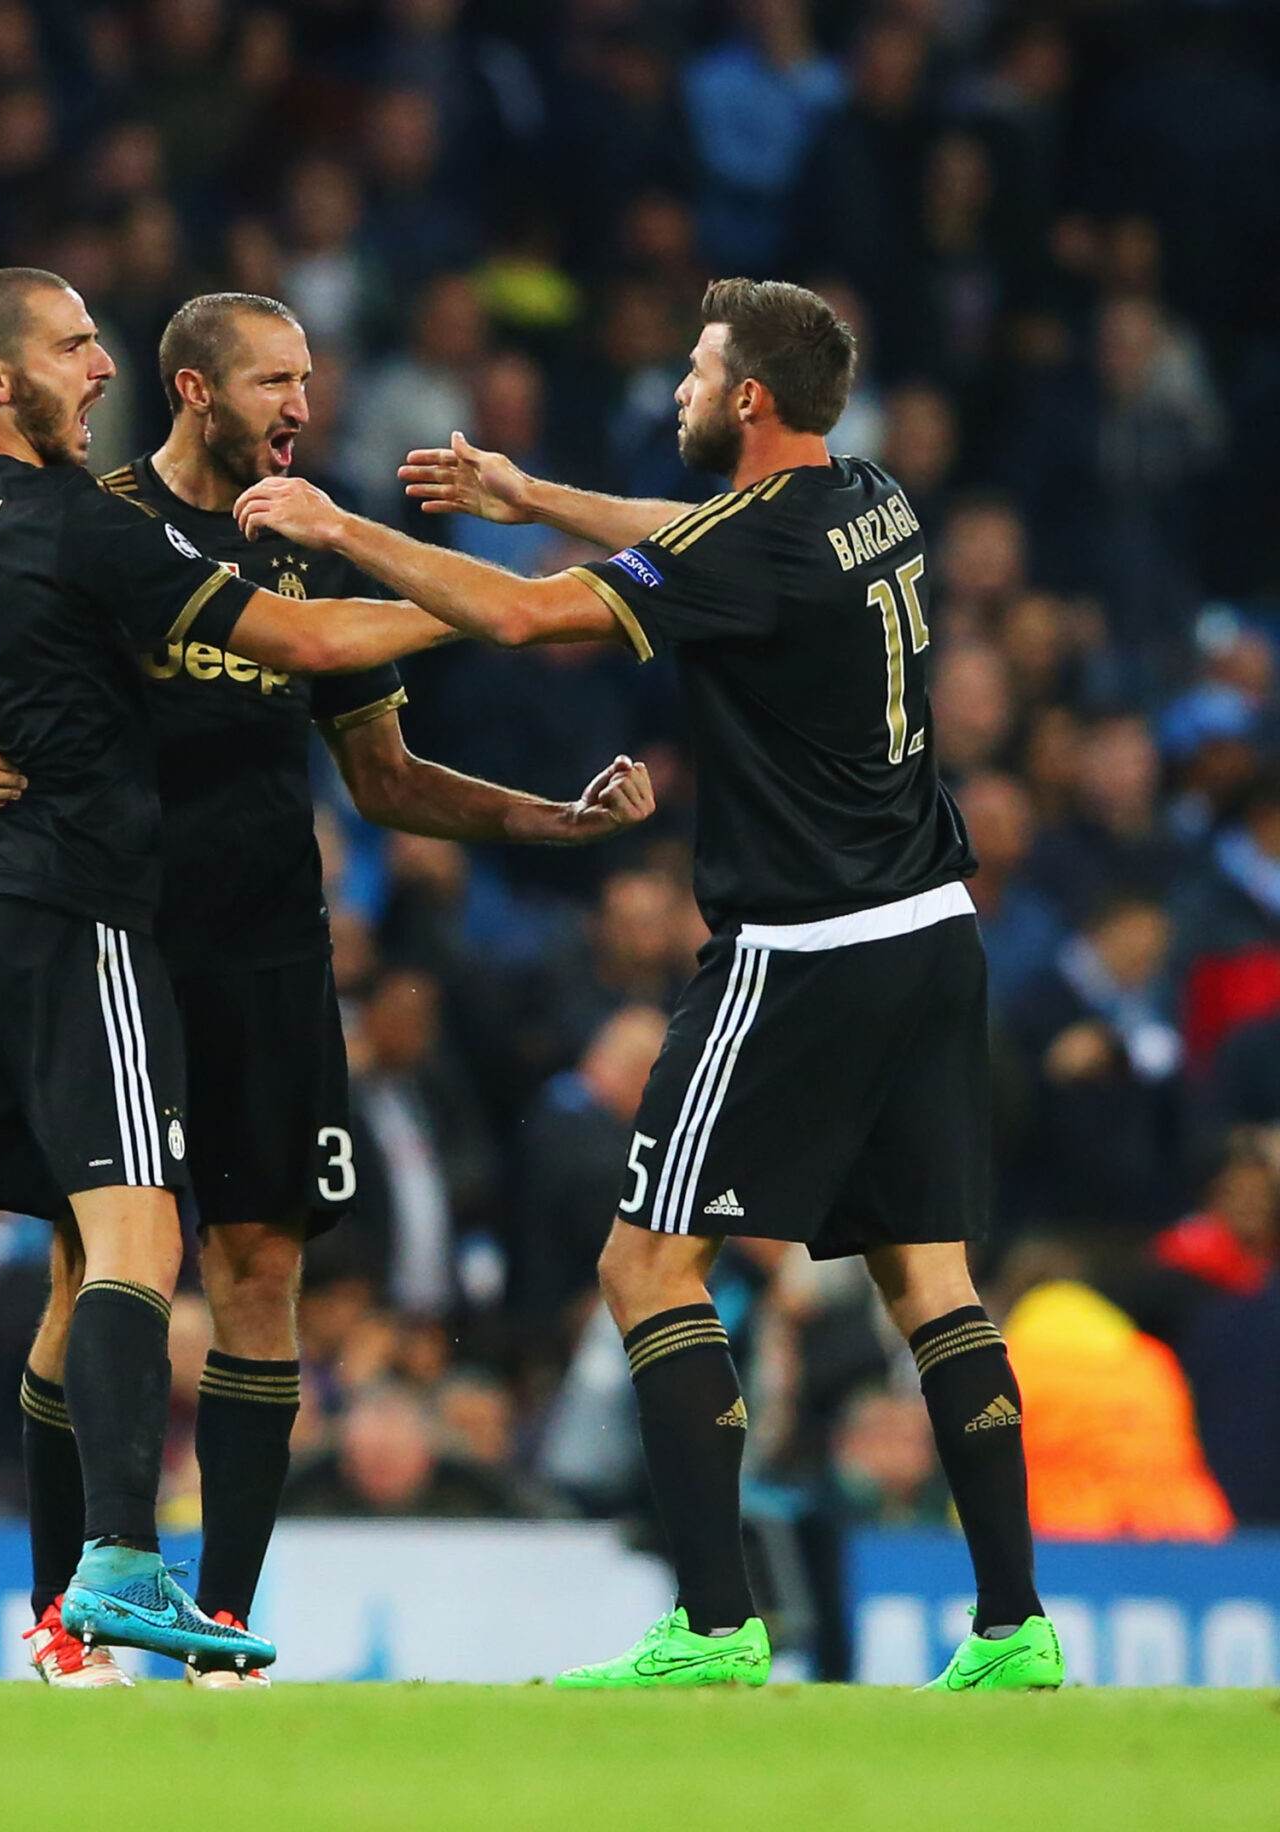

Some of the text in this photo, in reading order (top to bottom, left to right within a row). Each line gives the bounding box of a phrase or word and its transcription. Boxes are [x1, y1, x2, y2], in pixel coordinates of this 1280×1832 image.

[316, 1126, 357, 1202] 3
[618, 1130, 658, 1214] 5
[703, 1204, 745, 1217] adidas
